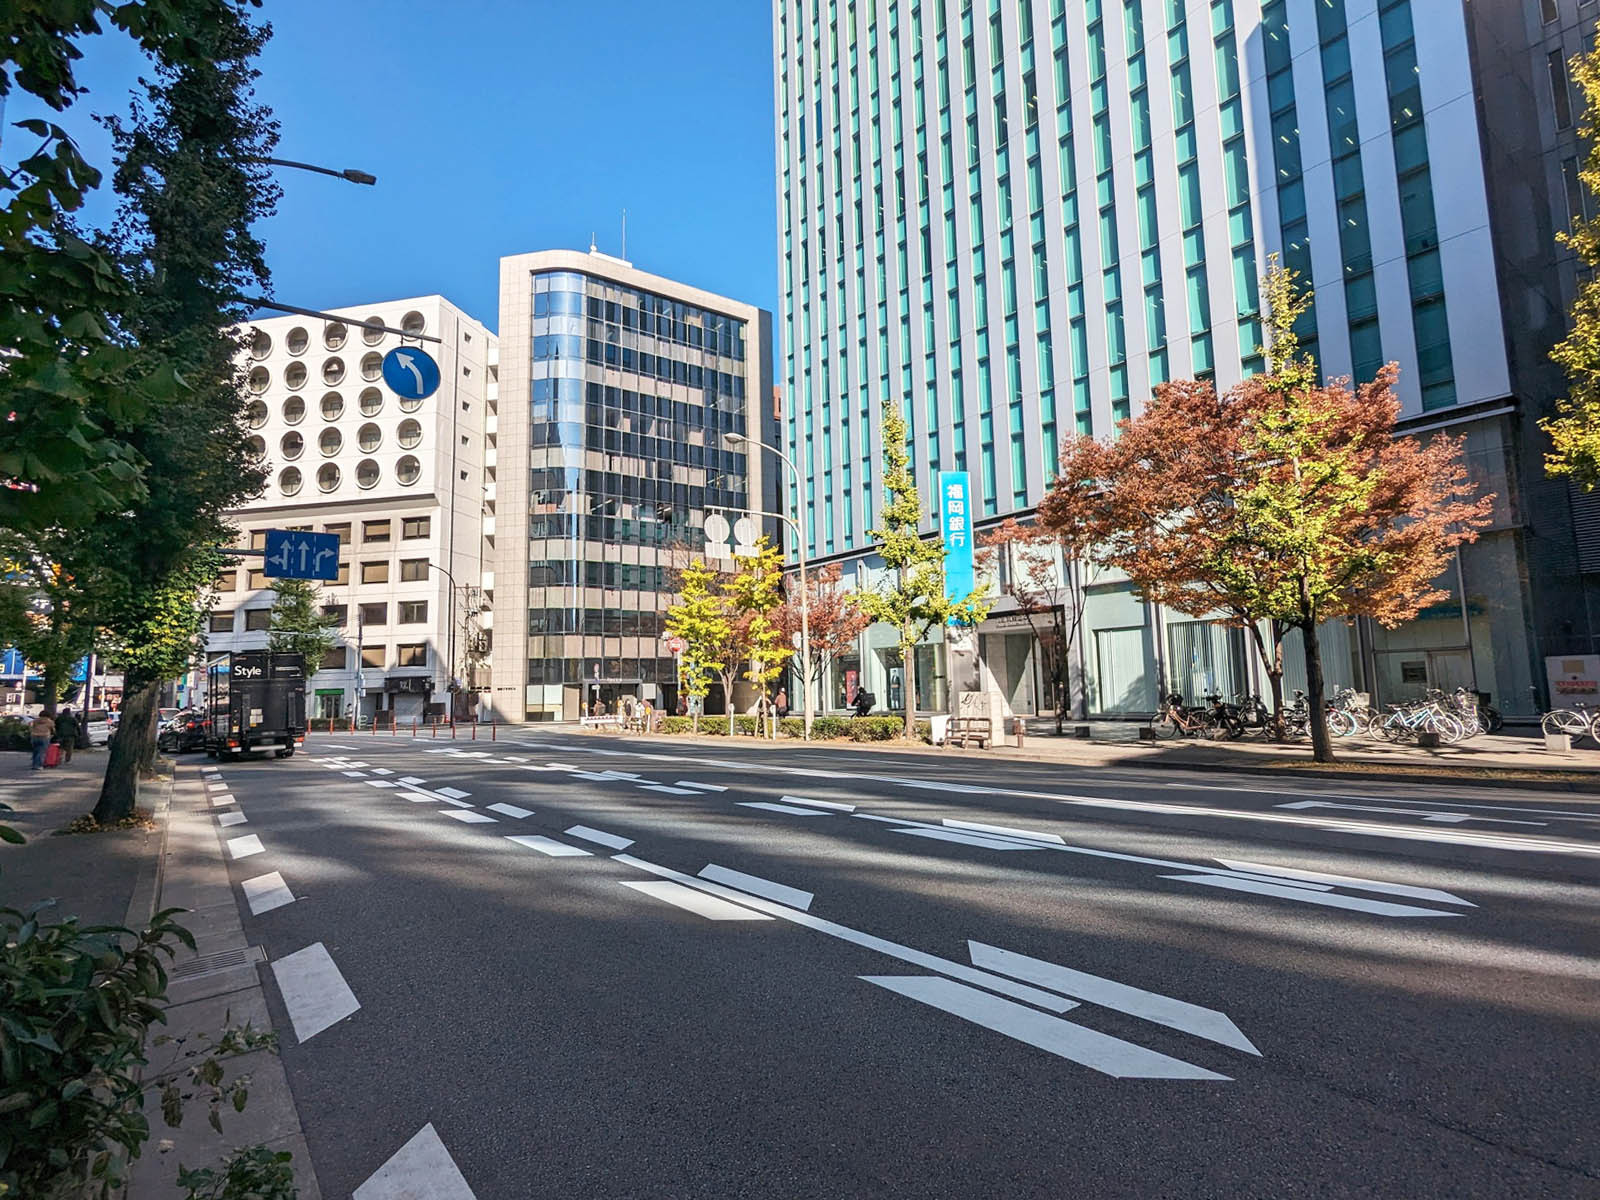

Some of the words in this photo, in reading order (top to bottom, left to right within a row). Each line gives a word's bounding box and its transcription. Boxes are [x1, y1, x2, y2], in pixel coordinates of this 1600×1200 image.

[947, 484, 965, 547] 福岡銀行
[233, 665, 262, 678] Style
